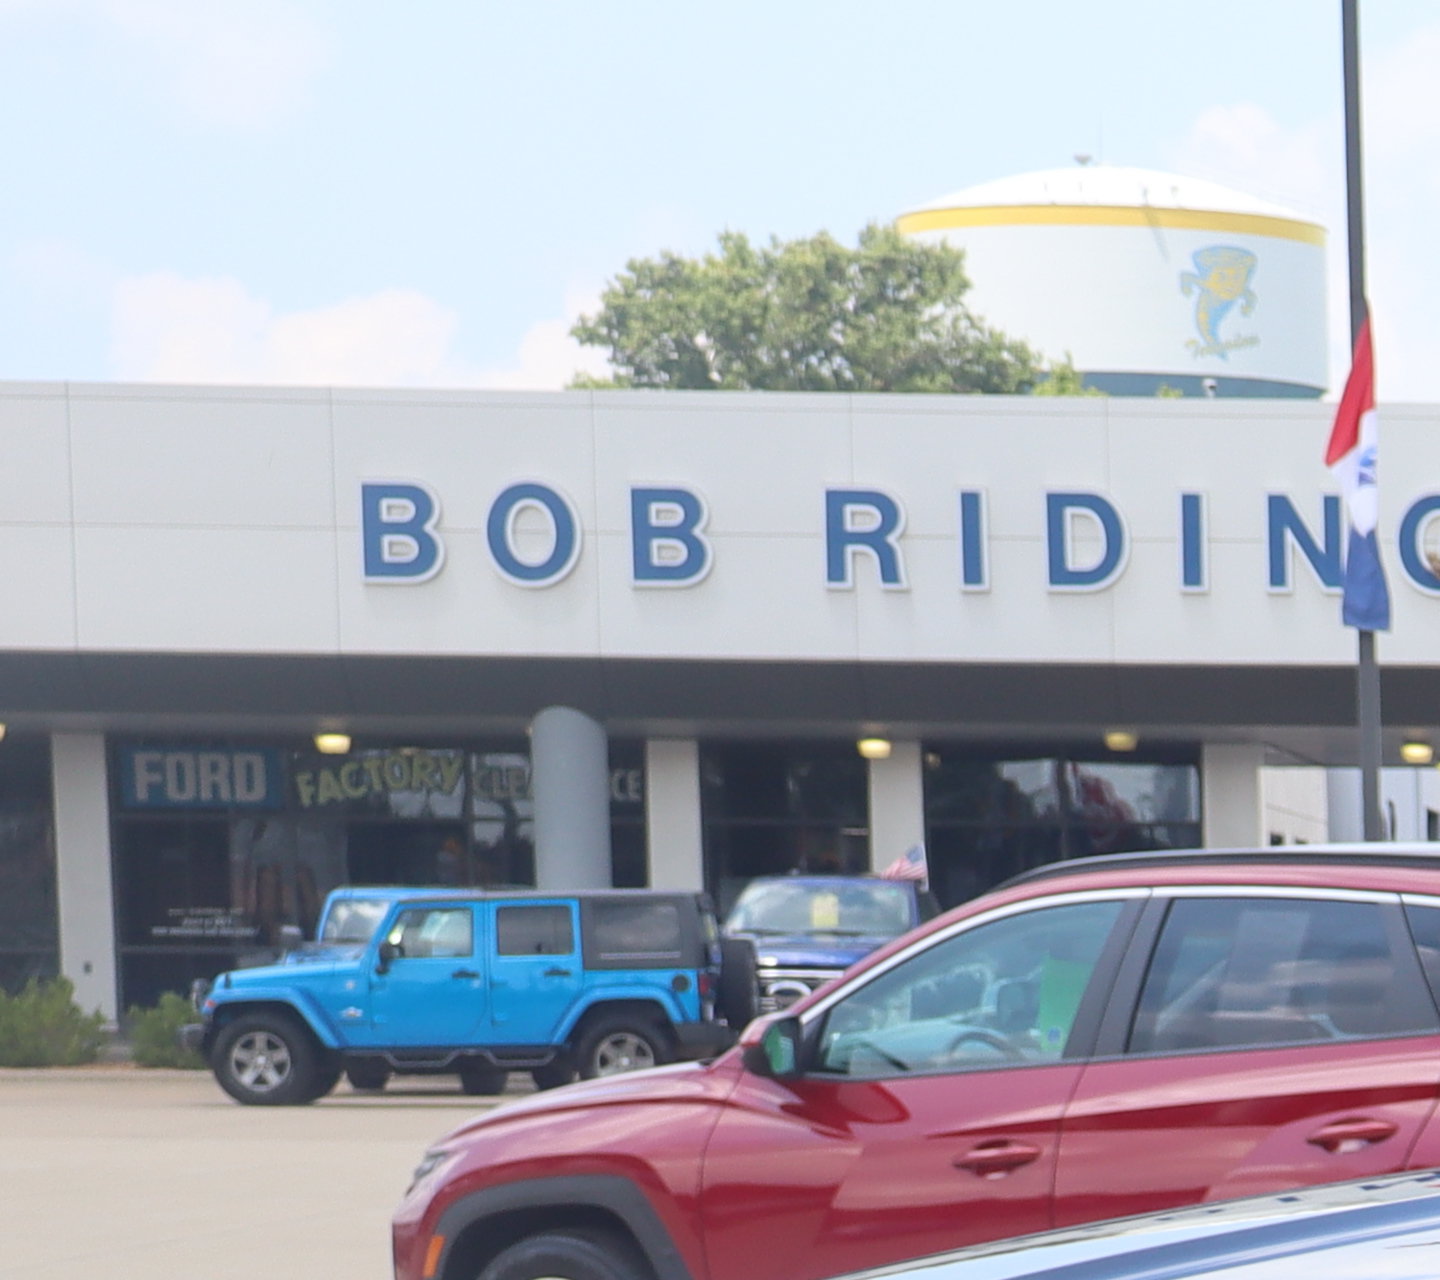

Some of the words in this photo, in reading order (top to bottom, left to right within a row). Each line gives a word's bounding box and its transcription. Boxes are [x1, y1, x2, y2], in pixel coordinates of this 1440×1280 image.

[360, 480, 713, 589] BOB
[134, 752, 267, 801] FORD
[296, 754, 464, 807] FACTORY
